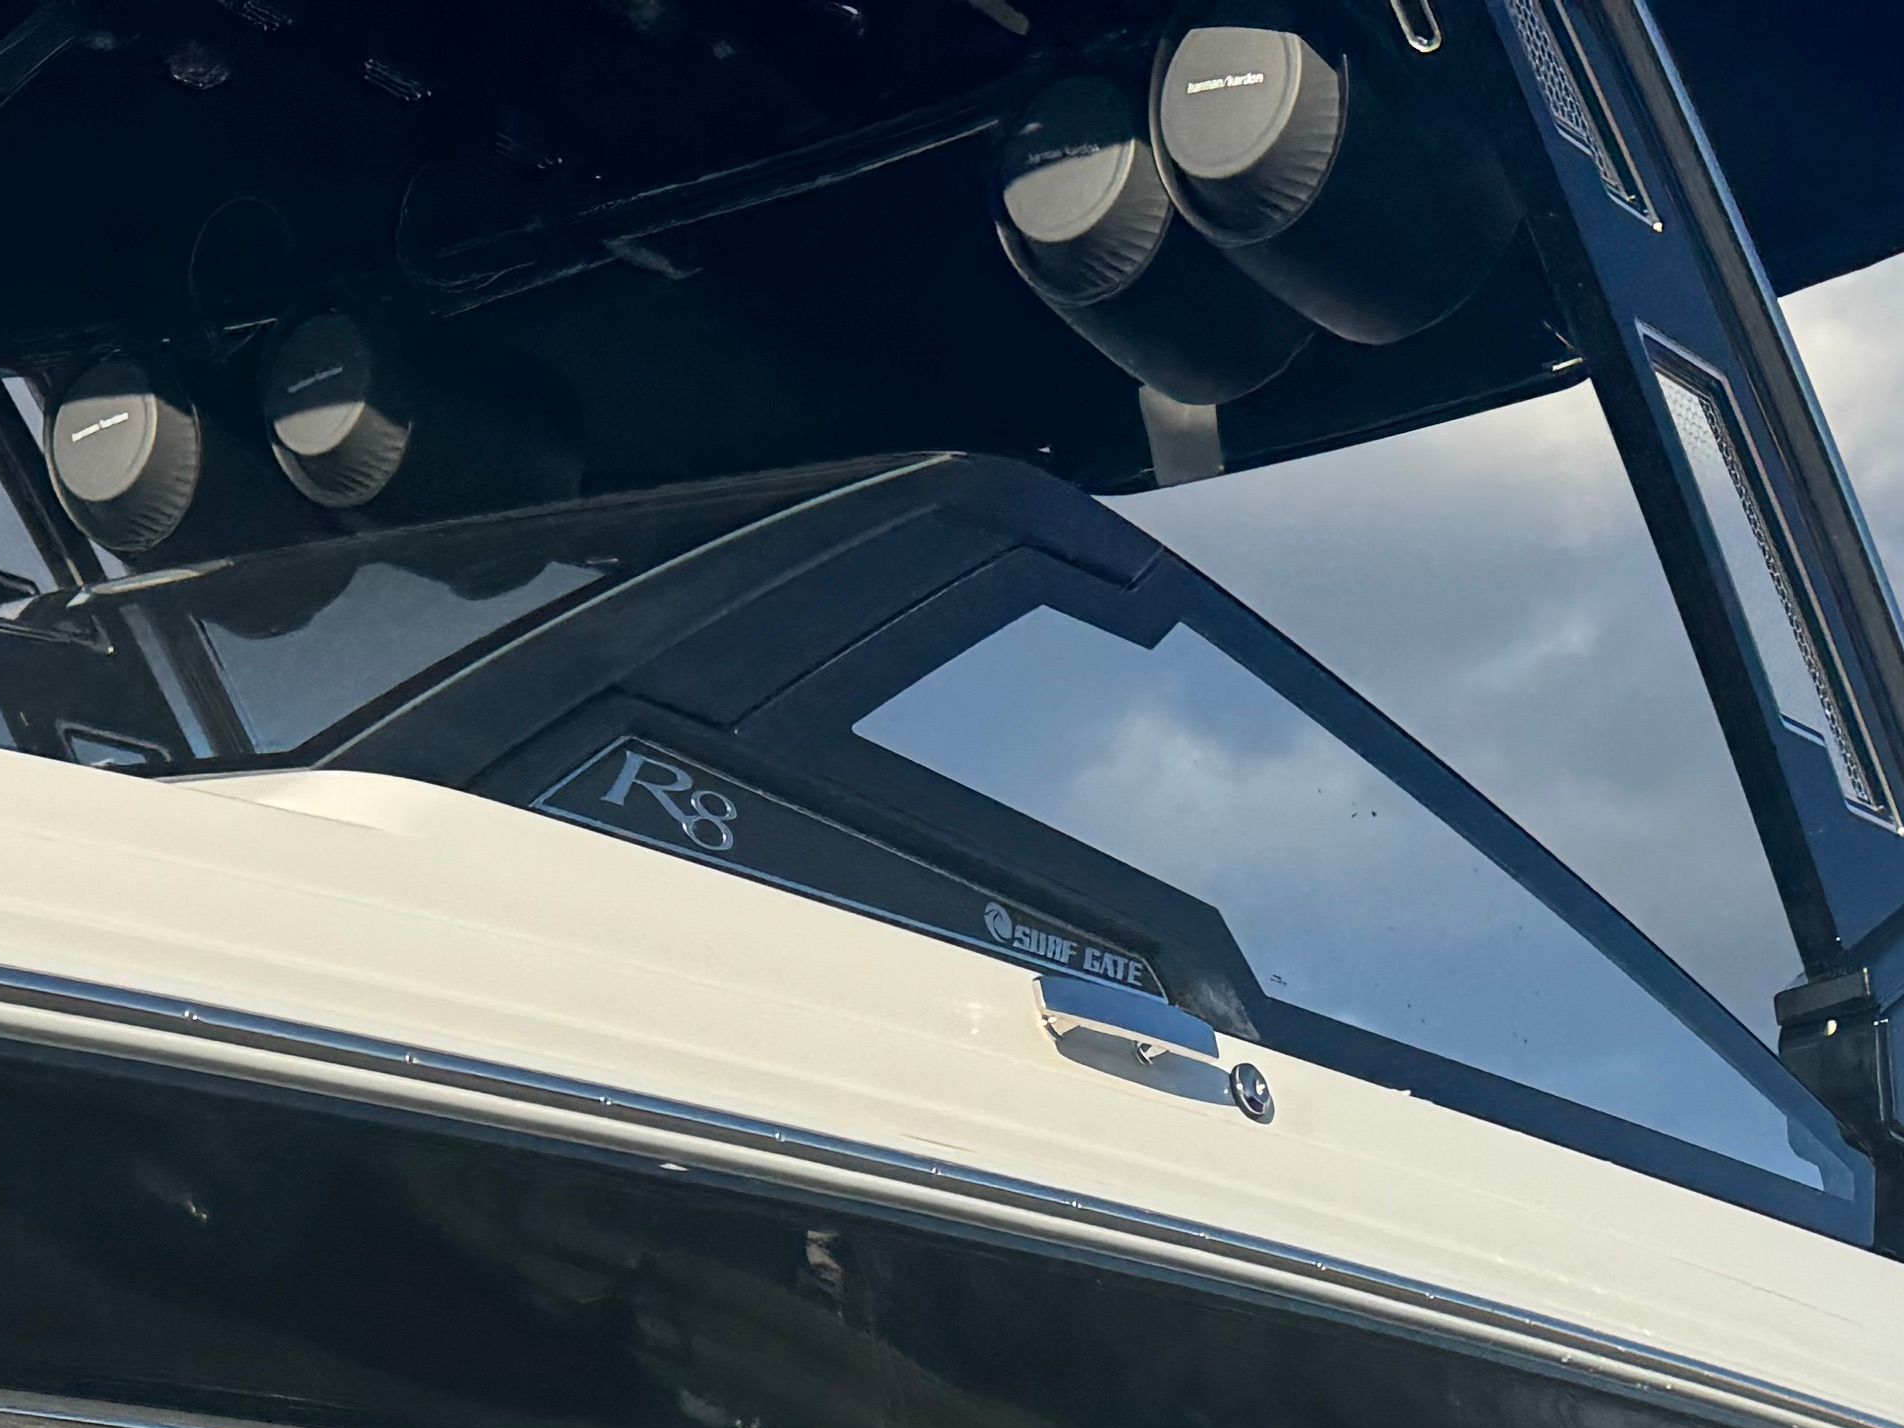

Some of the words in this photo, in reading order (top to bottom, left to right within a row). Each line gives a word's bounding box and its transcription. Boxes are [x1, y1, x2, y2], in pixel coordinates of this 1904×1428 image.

[600, 750, 737, 851] R8
[1012, 925, 1079, 965] SURF
[1082, 947, 1144, 986] GATE
